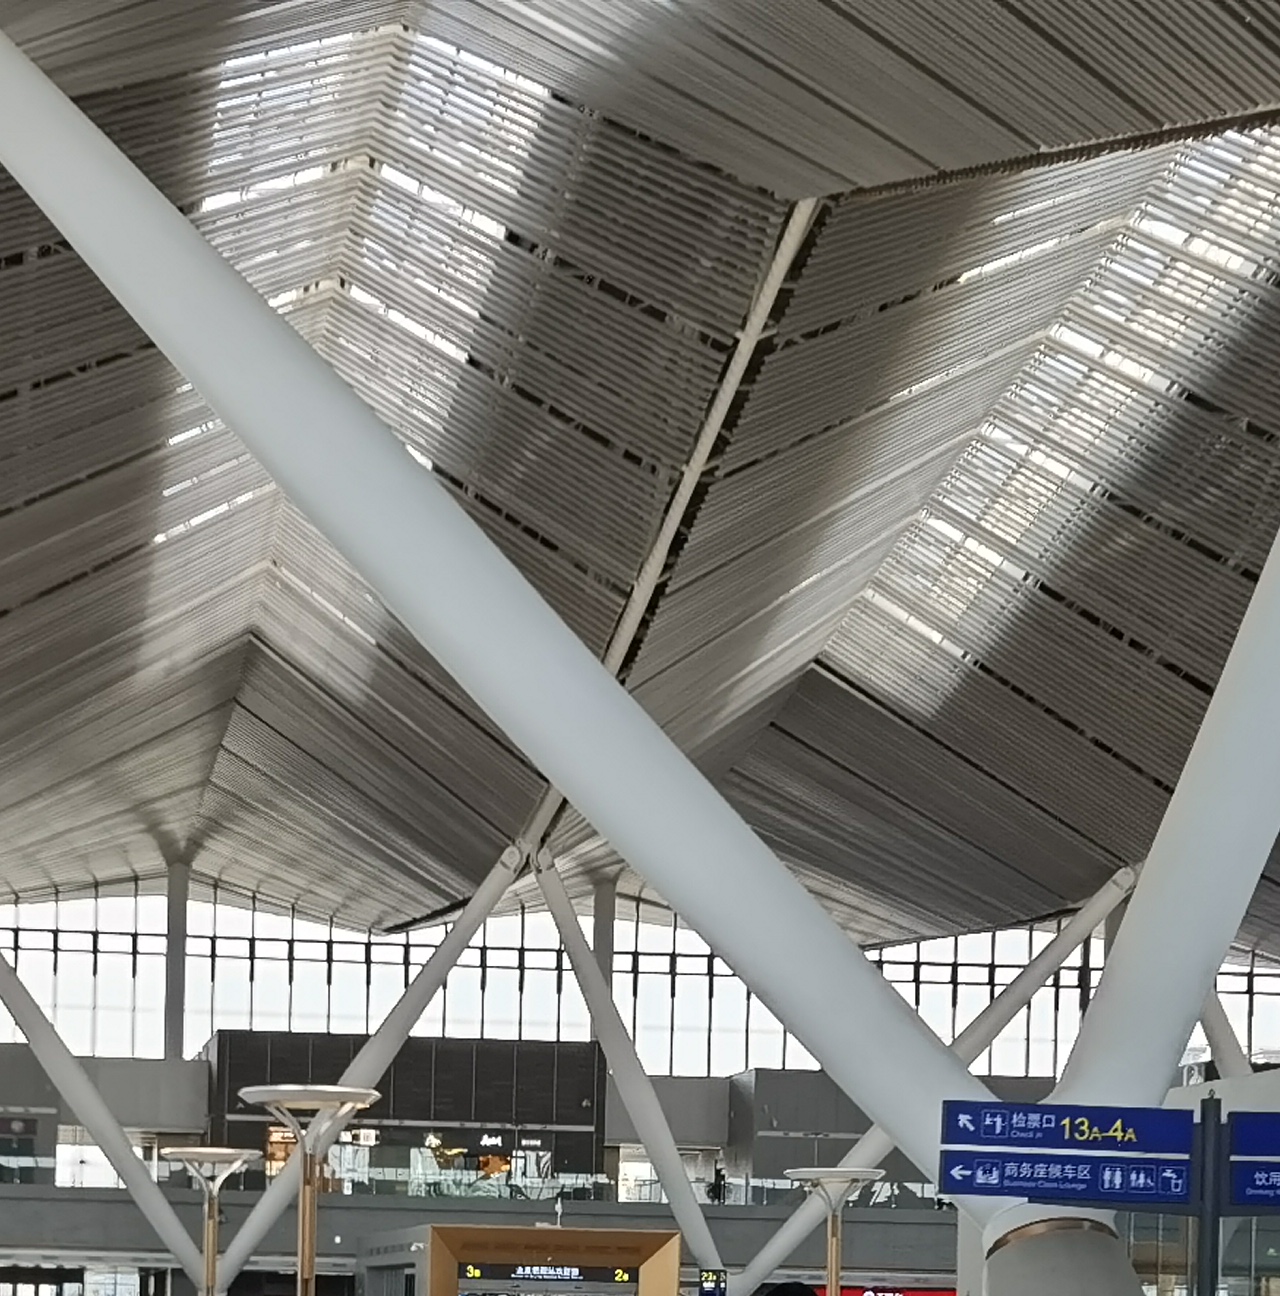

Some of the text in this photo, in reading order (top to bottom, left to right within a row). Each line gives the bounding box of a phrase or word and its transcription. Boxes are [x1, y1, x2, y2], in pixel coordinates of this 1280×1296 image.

[1010, 1112, 1138, 1142] 检票口 13A-4A
[1003, 1162, 1092, 1180] 商务座候车区
